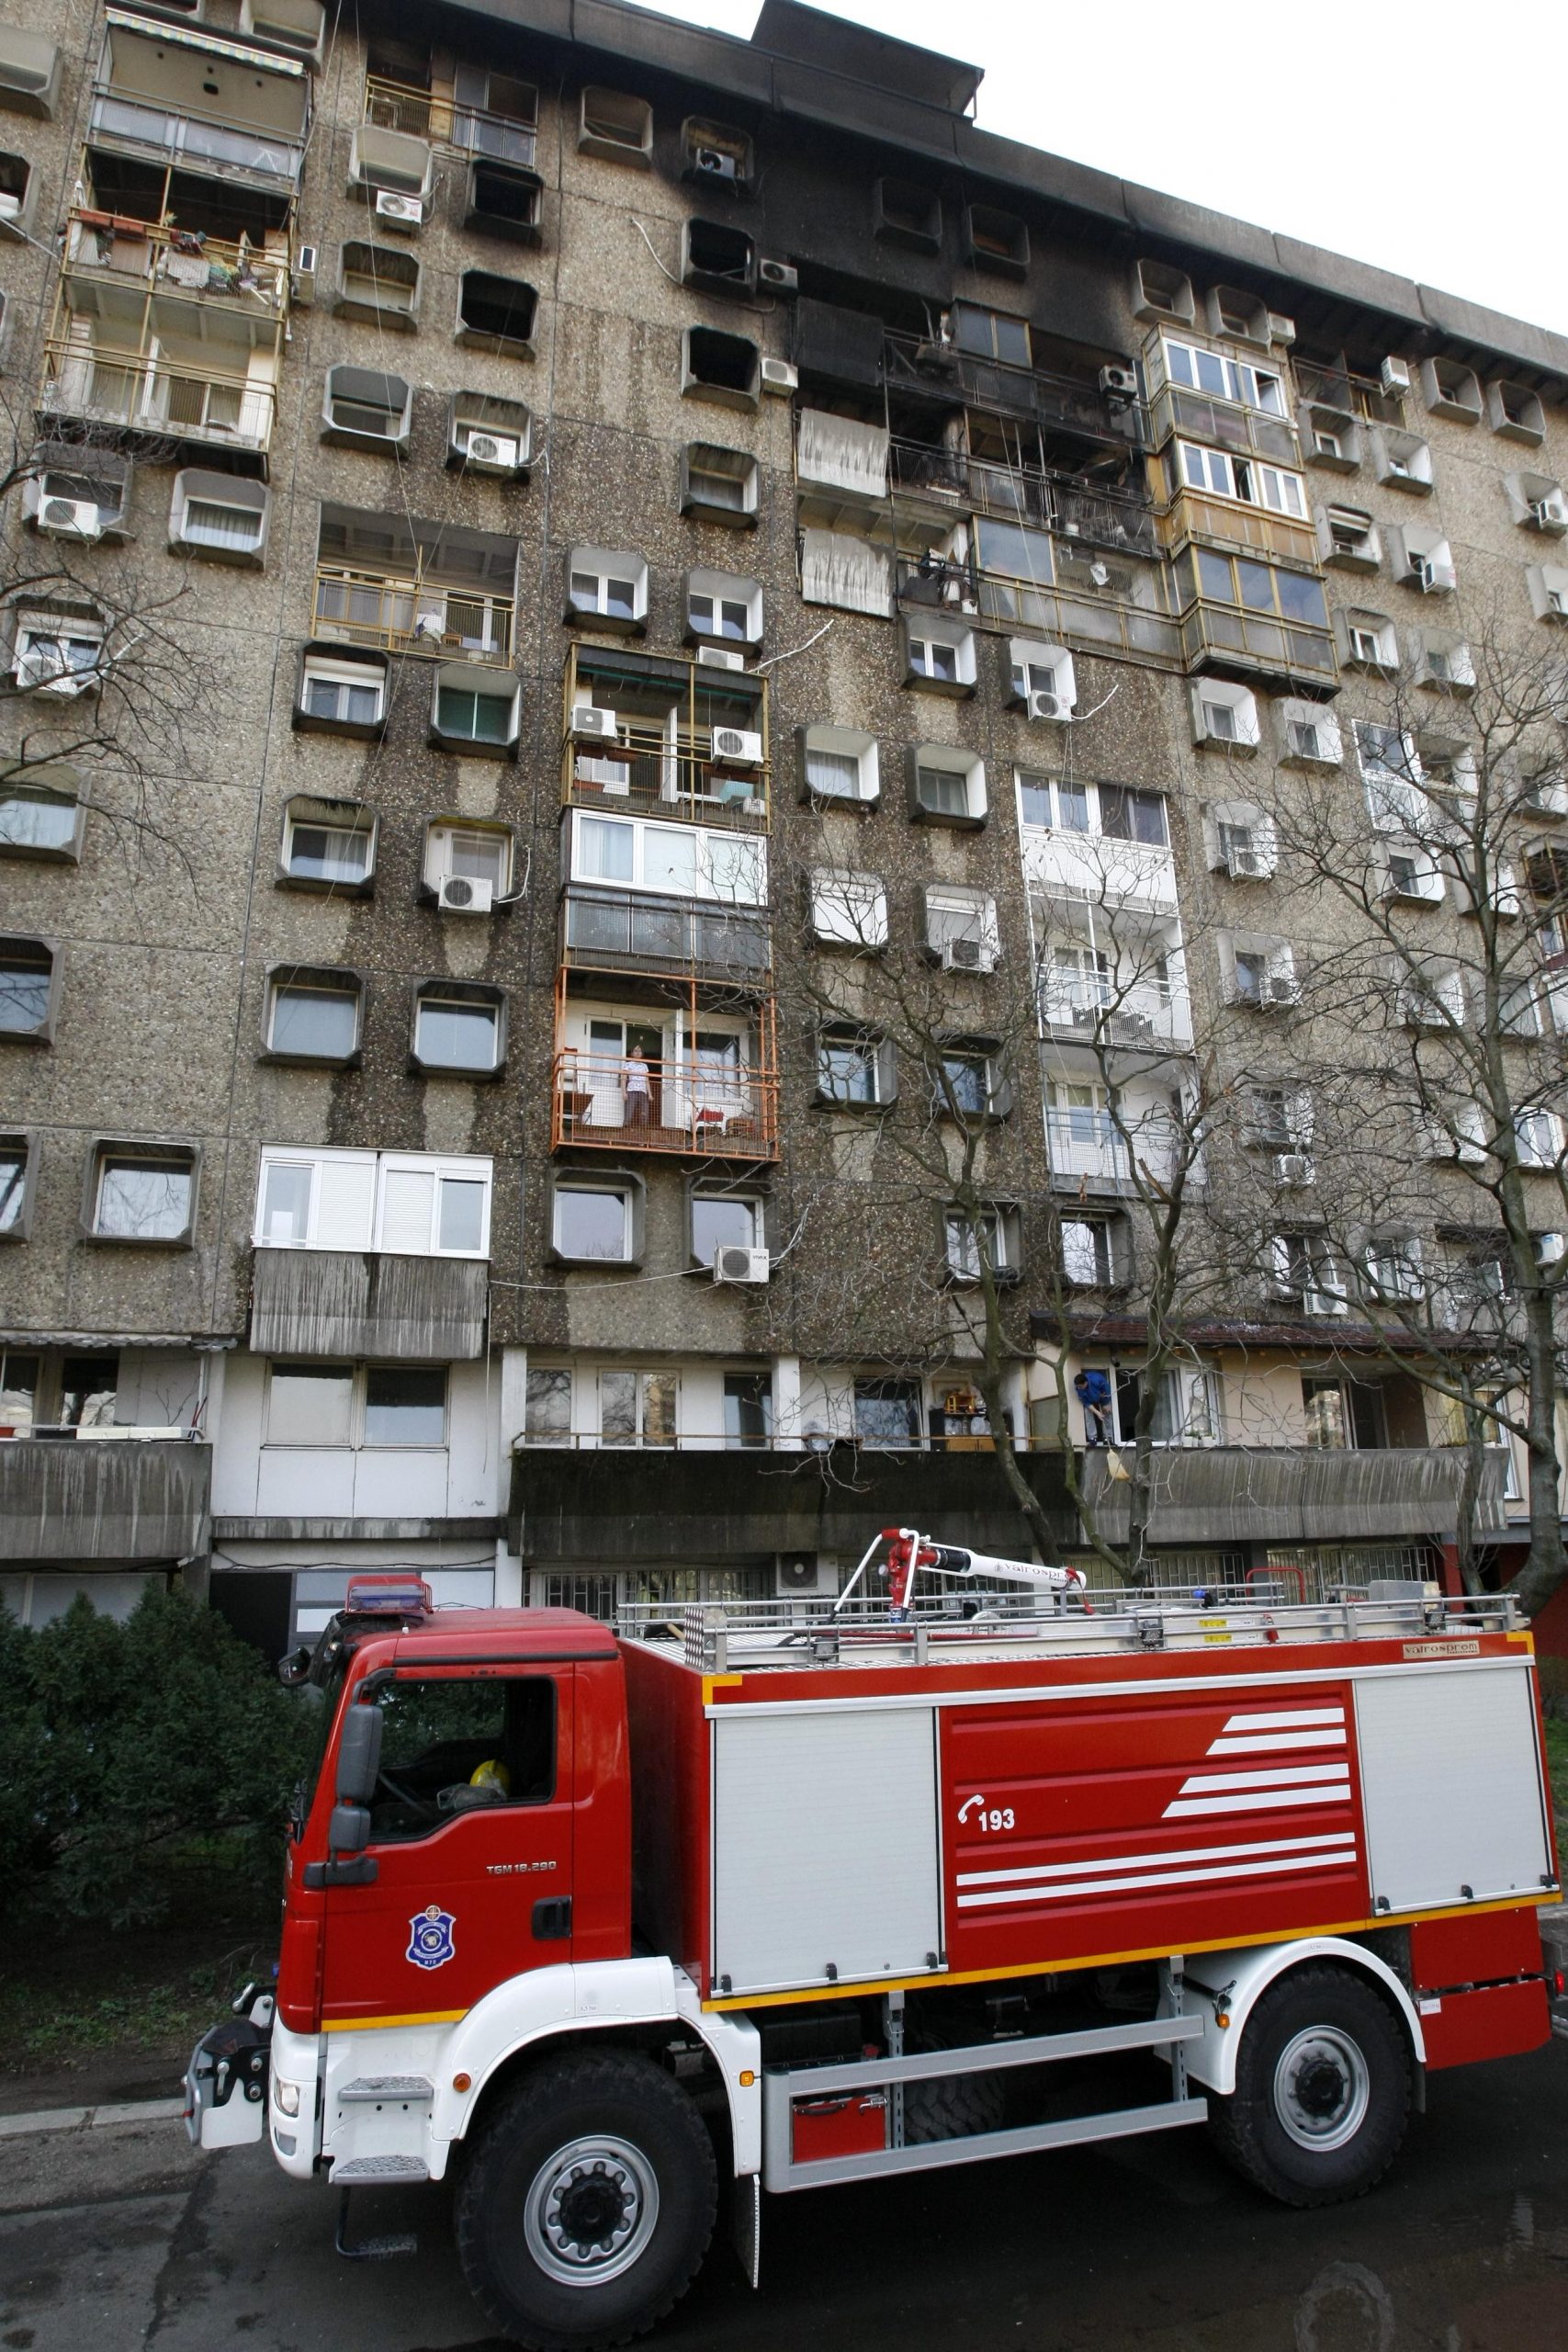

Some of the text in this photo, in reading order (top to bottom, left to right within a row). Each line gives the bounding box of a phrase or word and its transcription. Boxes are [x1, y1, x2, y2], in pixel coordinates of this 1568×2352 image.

[978, 1808, 1015, 1831] 193
[486, 1861, 557, 1876] TGM 18.290
